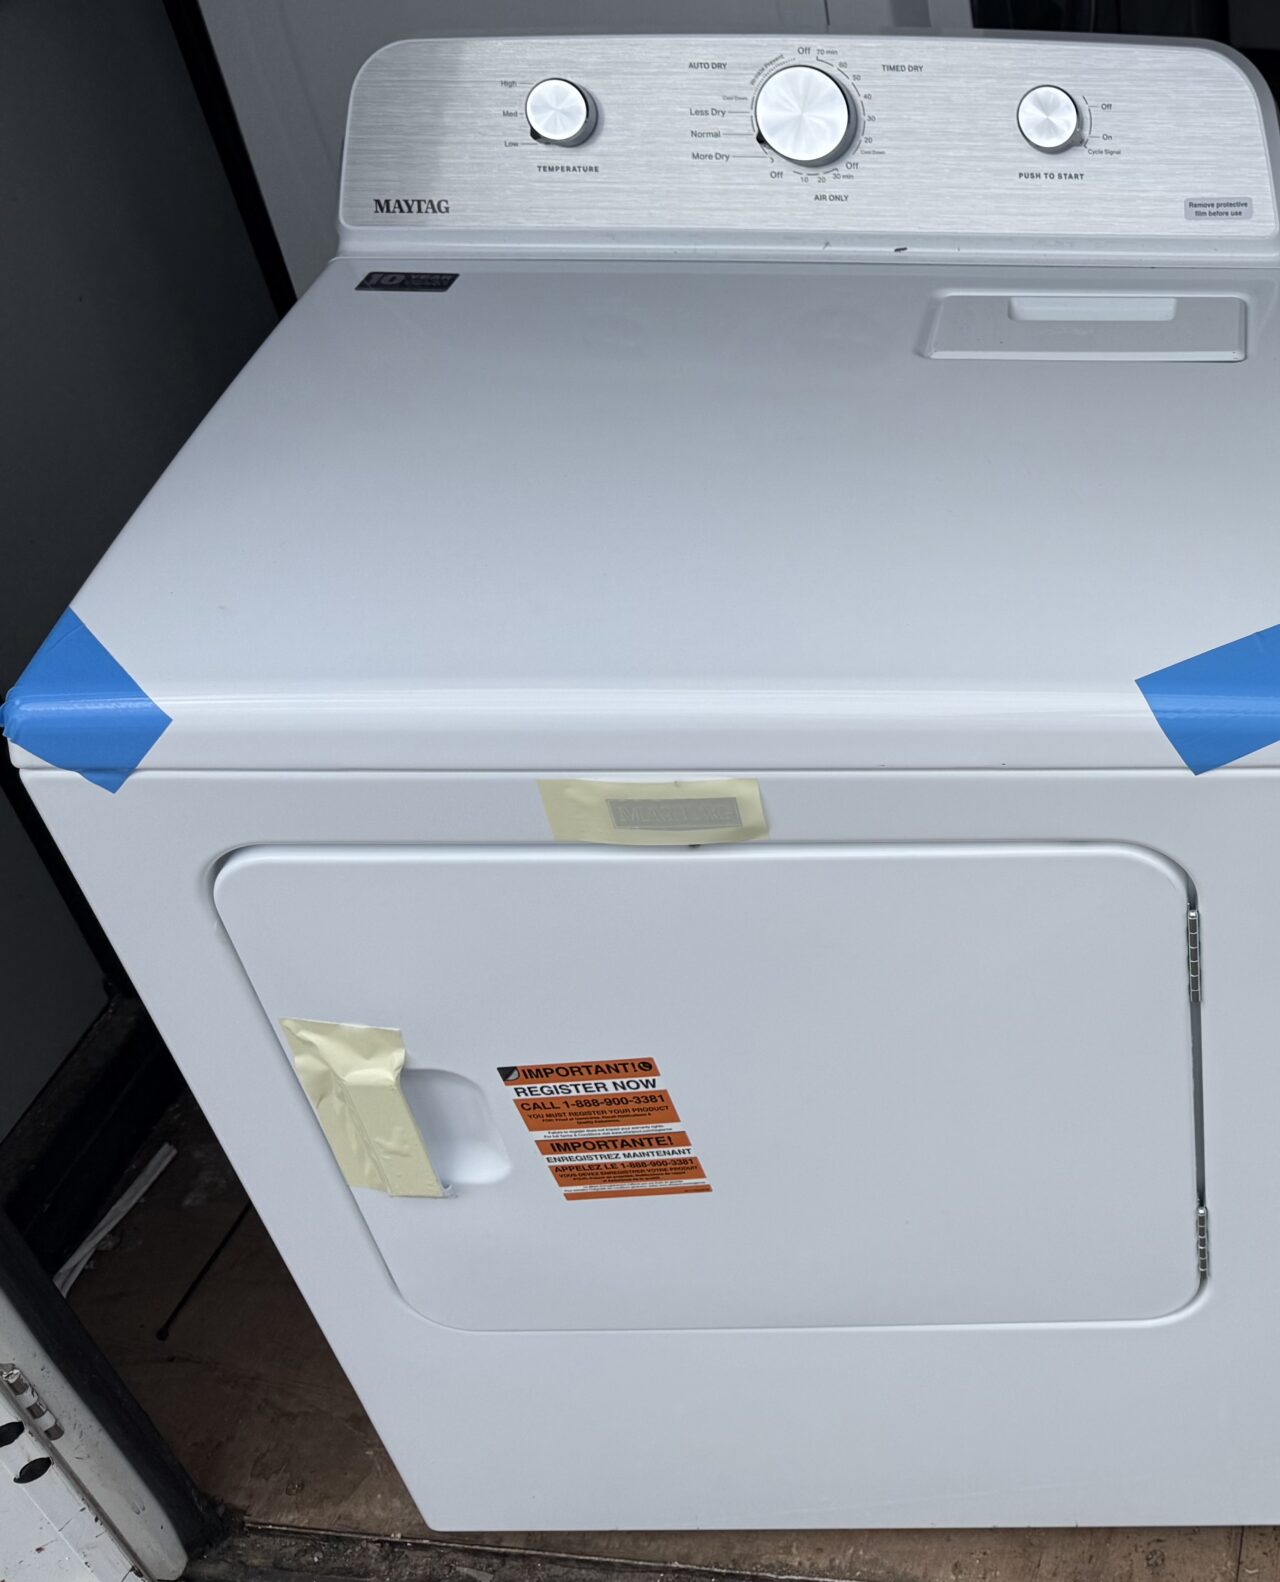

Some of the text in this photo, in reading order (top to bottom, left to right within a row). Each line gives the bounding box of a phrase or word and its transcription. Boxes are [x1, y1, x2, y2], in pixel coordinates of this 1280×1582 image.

[798, 47, 810, 55] Off
[501, 79, 517, 89] High
[710, 109, 726, 117] Dry
[715, 153, 729, 161] Dry
[374, 199, 450, 214] MAYTAG
[1216, 201, 1248, 209] protective
[522, 1062, 637, 1079] IMPORTANT!
[514, 1079, 657, 1097] REGISTER NOW
[521, 1094, 666, 1111] CALL 1-888-900-3381
[632, 1105, 669, 1113] PRODUCT
[550, 1136, 674, 1152] IMPORTANTE!
[546, 1148, 692, 1163] ENREGISTREZ MAINTENANT
[555, 1164, 601, 1172] APPELEZ
[620, 1158, 694, 1168] 1-888-900-3381
